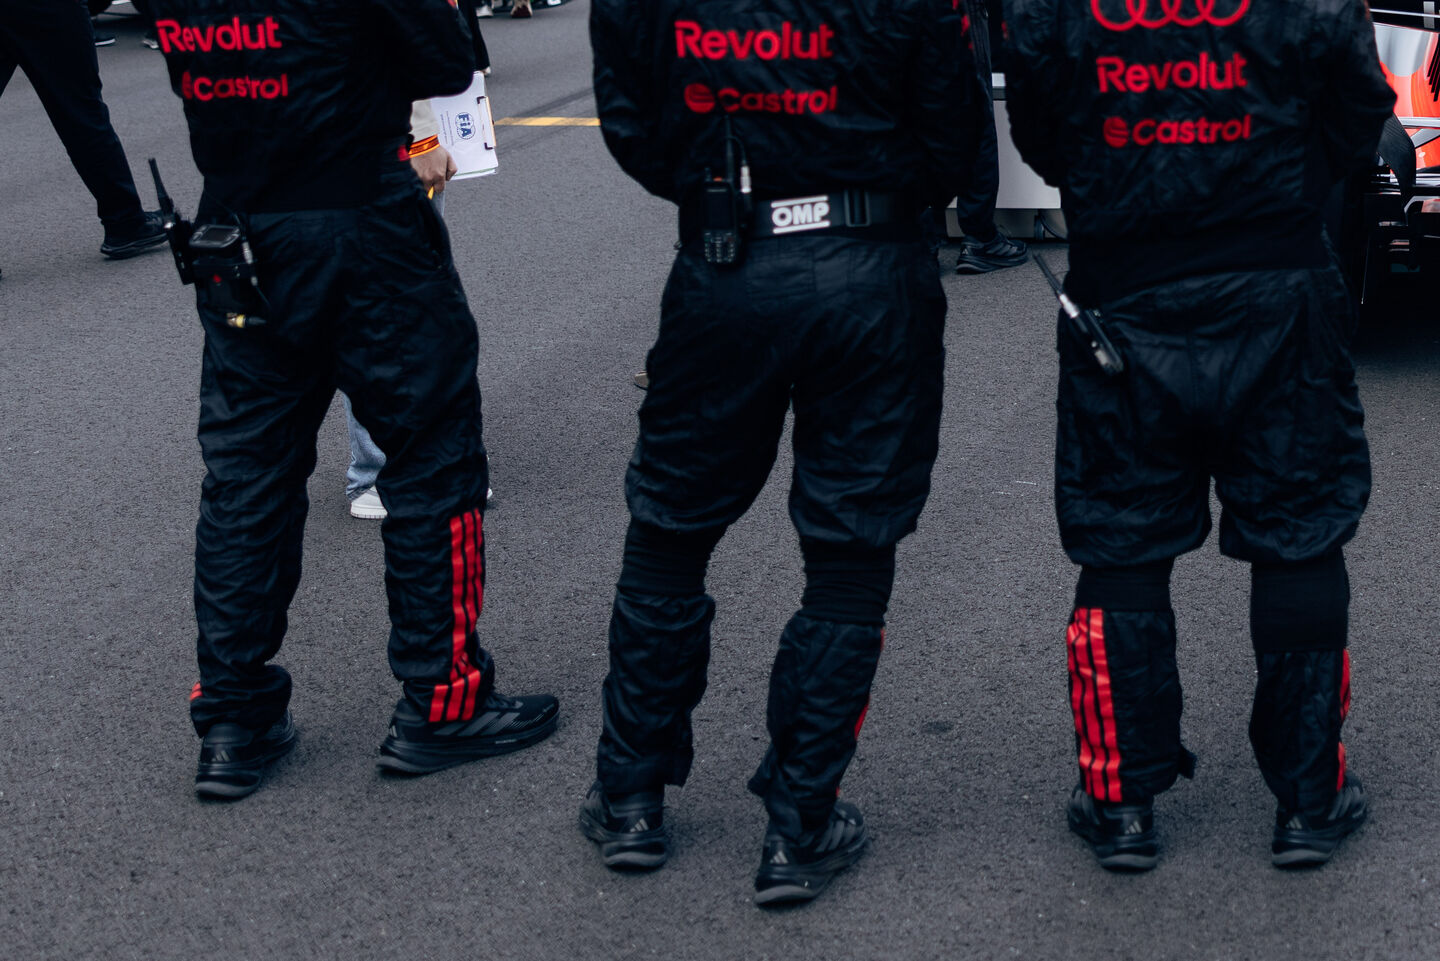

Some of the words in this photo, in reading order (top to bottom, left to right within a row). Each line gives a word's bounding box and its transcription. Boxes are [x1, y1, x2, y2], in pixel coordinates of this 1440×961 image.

[156, 16, 282, 53] Revolut
[675, 20, 833, 60] Revolut
[1096, 52, 1247, 92] Revolut
[193, 75, 288, 101] Castrol
[719, 87, 836, 114] Castrol
[1133, 115, 1250, 145] Castrol
[771, 203, 829, 227] OMP
